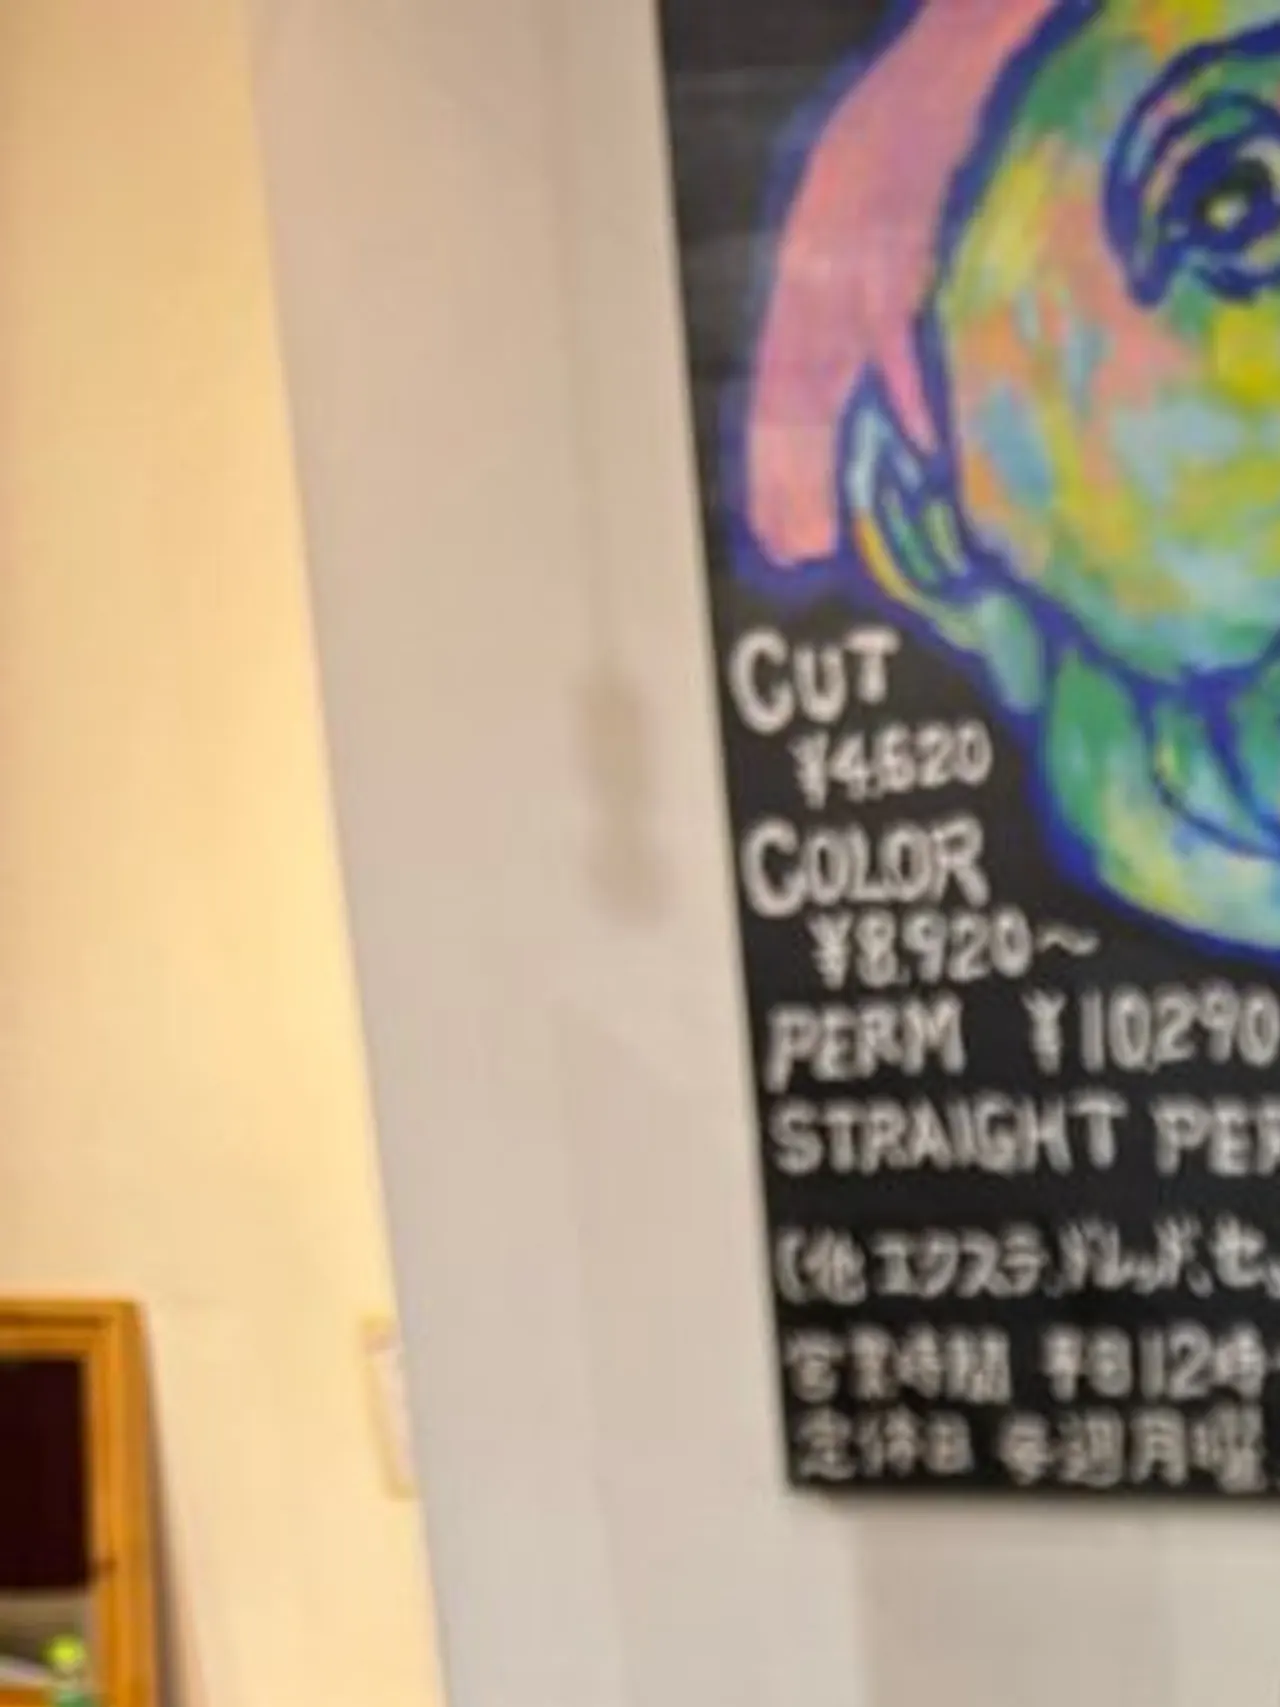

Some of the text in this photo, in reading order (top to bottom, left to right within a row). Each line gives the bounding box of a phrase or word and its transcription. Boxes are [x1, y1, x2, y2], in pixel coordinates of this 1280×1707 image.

[729, 628, 900, 735] CUT
[742, 815, 990, 918] COLOR
[766, 992, 966, 1092] PERM
[768, 1090, 1128, 1177] STRAIGHT
